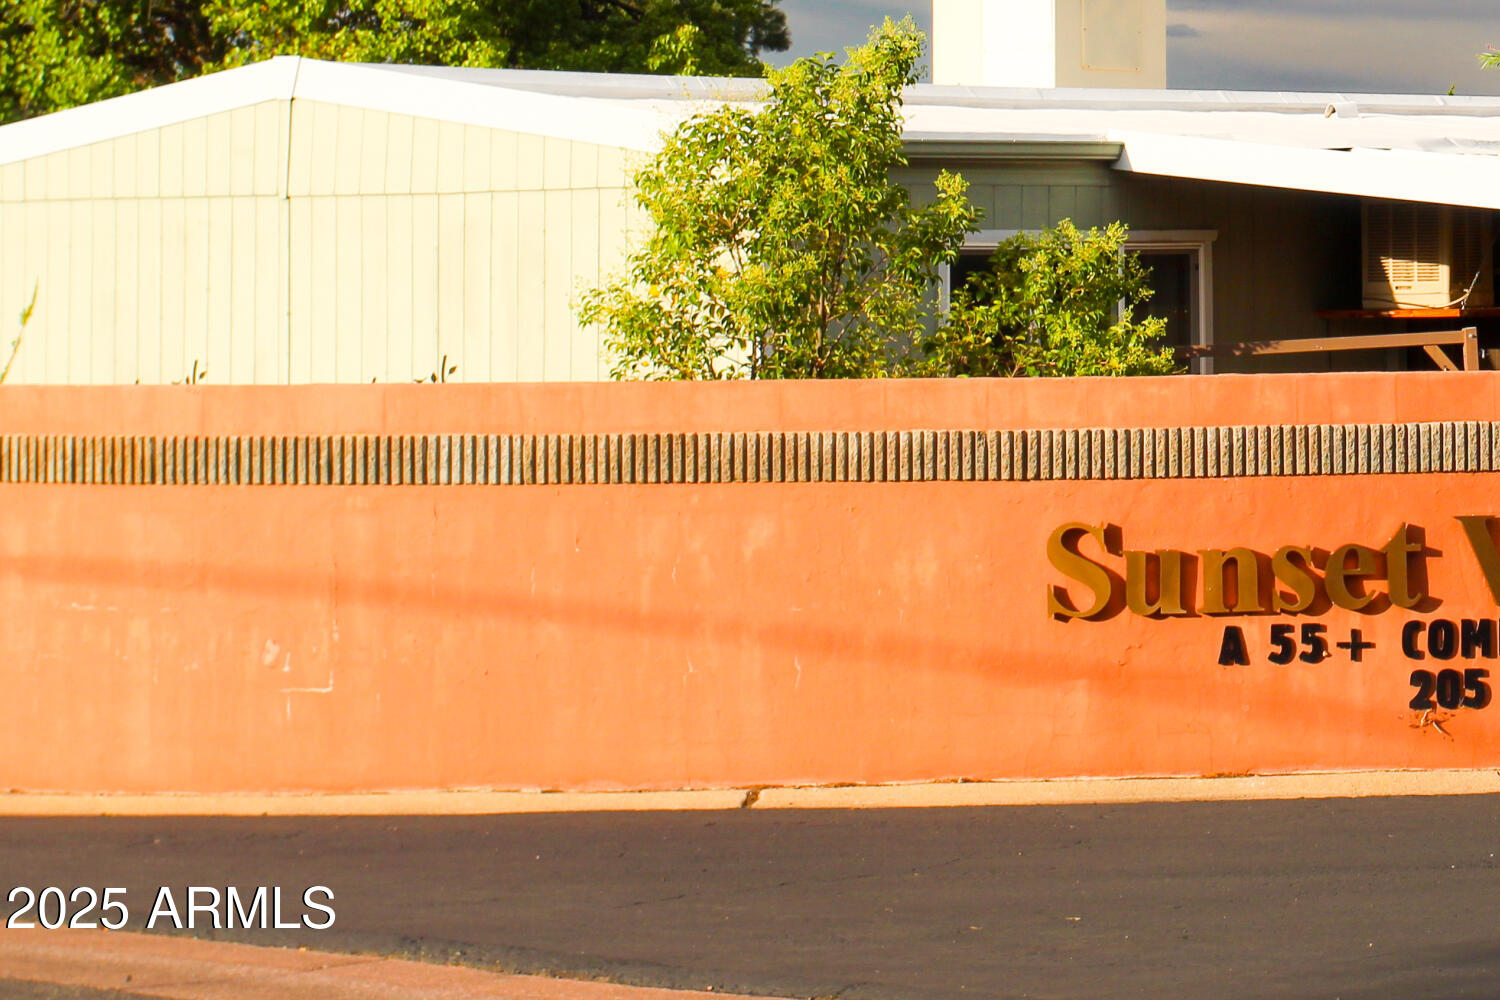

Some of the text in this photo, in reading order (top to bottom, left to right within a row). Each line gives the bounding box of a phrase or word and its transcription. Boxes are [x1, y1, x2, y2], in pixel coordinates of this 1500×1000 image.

[1046, 521, 1423, 619] Sunset
[1217, 625, 1250, 665] A
[1268, 623, 1376, 664] 55+
[1409, 668, 1491, 710] 205
